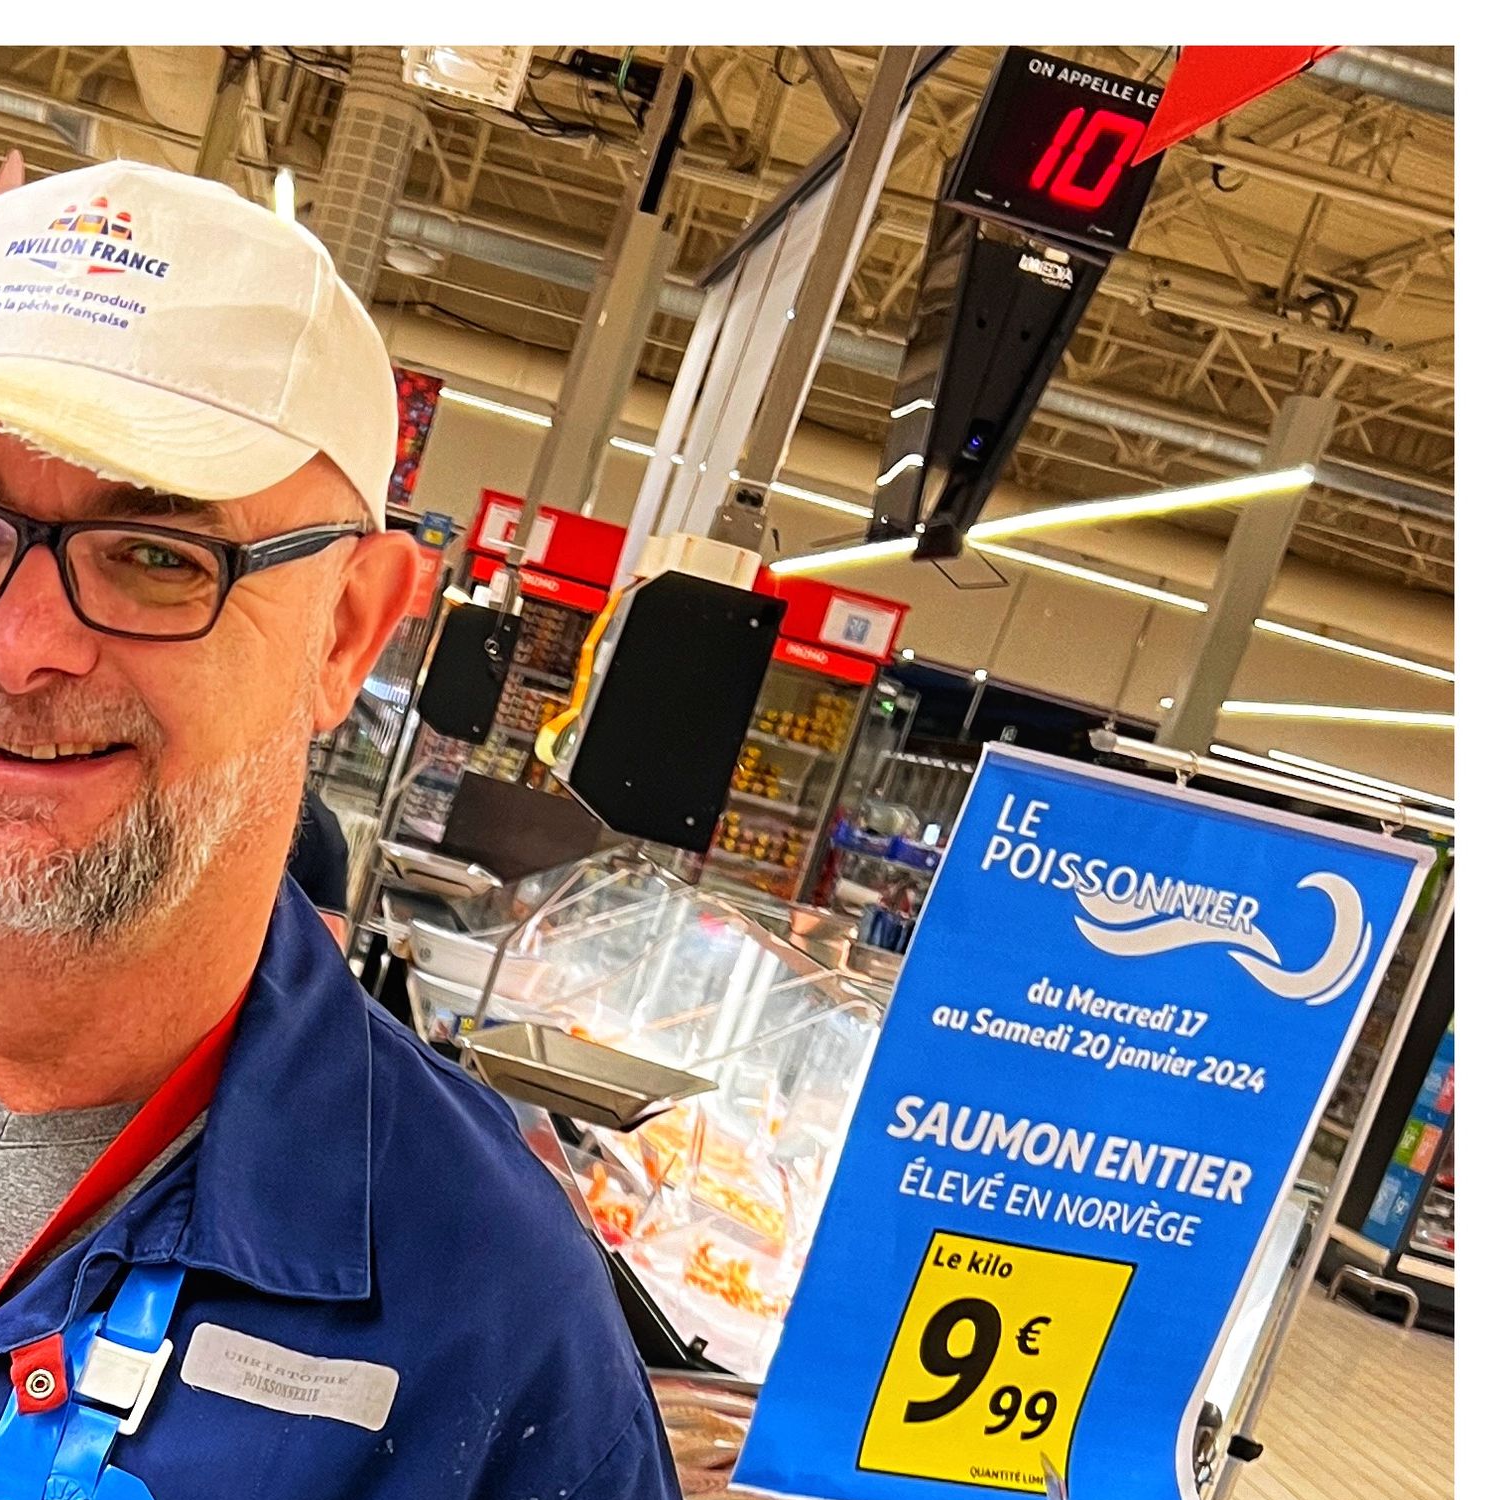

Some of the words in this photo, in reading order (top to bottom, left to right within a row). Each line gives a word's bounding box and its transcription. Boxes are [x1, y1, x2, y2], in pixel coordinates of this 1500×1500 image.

[1028, 58, 1056, 77] ON
[1057, 68, 1134, 101] APPELLE
[1136, 89, 1160, 109] LE
[1029, 107, 1146, 208] 10
[5, 237, 88, 257] PAVILLON
[89, 240, 170, 278] FRANCE
[3, 283, 53, 294] marque
[56, 283, 80, 297] des
[82, 291, 147, 315] produits
[4, 298, 15, 310] la
[17, 299, 59, 312] pêche
[62, 304, 129, 329] française
[996, 793, 1049, 838] LE
[981, 835, 1260, 934] POISSONNIER
[1027, 977, 1063, 1008] du
[1065, 984, 1178, 1033] Mercredi
[1175, 1009, 1209, 1038] 17
[932, 1005, 969, 1031] au
[970, 1007, 1074, 1053] Samedi
[1072, 1030, 1111, 1060] 20
[1105, 1036, 1197, 1078] janvier
[1197, 1055, 1266, 1094] 2024
[886, 1095, 1096, 1174] SAUMON
[1094, 1135, 1252, 1205] ENTIER
[899, 1156, 1005, 1211] ÉLEVÉ
[1005, 1183, 1052, 1220] EN
[1053, 1193, 1202, 1247] NORVÈGE
[933, 1246, 962, 1270] Le
[967, 1250, 1013, 1279] kilo
[903, 1297, 1002, 1423] 9
[1015, 1316, 1052, 1356] €
[224, 1350, 349, 1386] CHRISTOPHE
[242, 1372, 320, 1402] POISSONNERIE
[984, 1385, 1058, 1441] 99
[970, 1465, 1020, 1482] QUANTITÉ
